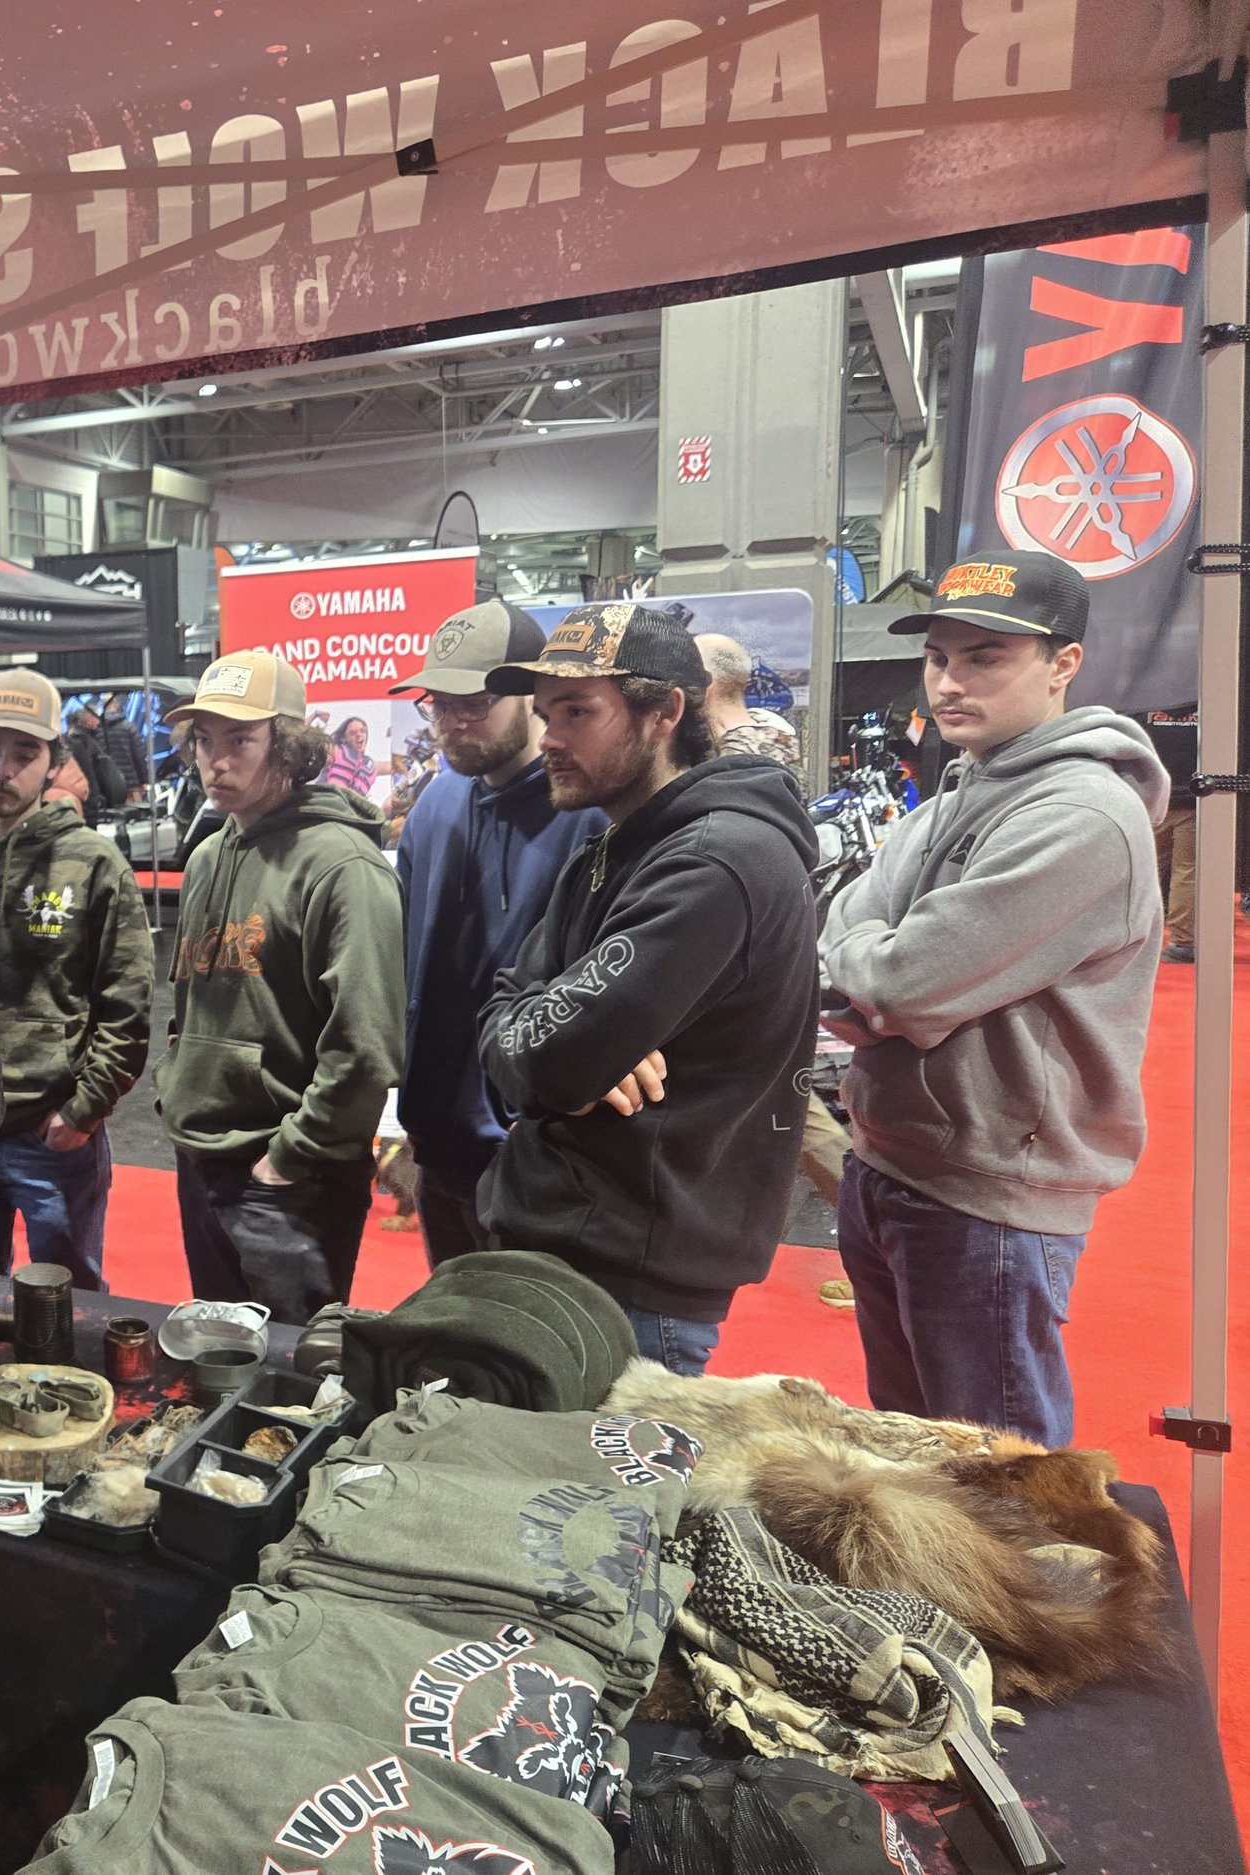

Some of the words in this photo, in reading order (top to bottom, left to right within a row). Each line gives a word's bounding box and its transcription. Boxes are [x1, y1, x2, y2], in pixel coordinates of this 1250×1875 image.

[317, 587, 407, 616] YAMAHA
[253, 637, 320, 665] AND
[326, 633, 430, 658] CONCOU
[299, 659, 399, 684] YAMAHA
[590, 1421, 666, 1486] BLACK
[404, 1668, 465, 1762] ACK
[274, 1756, 410, 1858] WOLF
